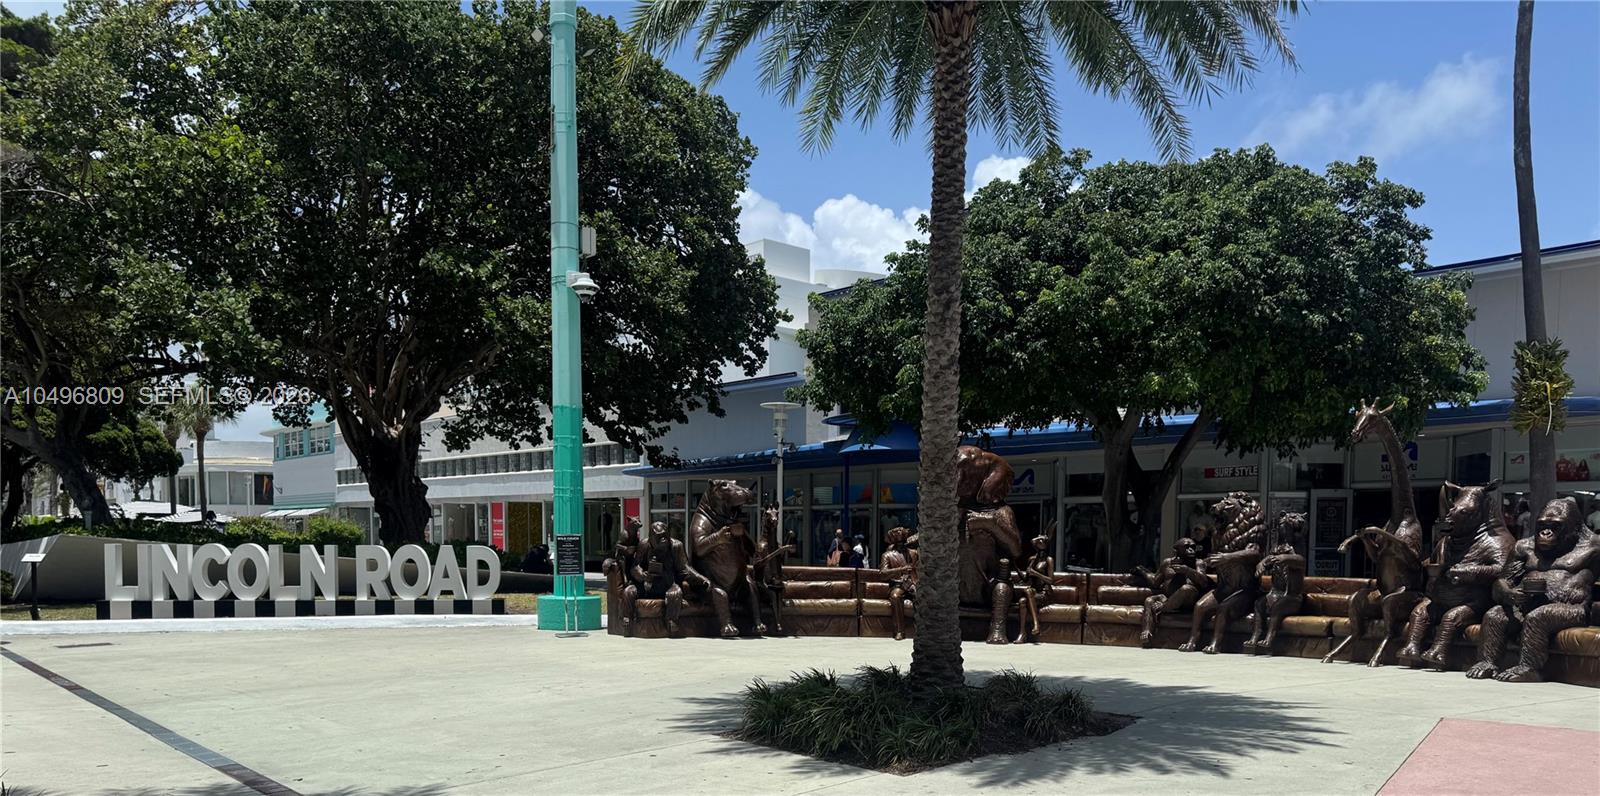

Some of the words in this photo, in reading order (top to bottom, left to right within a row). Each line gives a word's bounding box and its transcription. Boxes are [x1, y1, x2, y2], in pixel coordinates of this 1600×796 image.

[1215, 467, 1234, 477] SURF
[1235, 466, 1258, 476] STYLE
[104, 542, 338, 601] LINCOLN
[355, 542, 501, 601] ROAD
